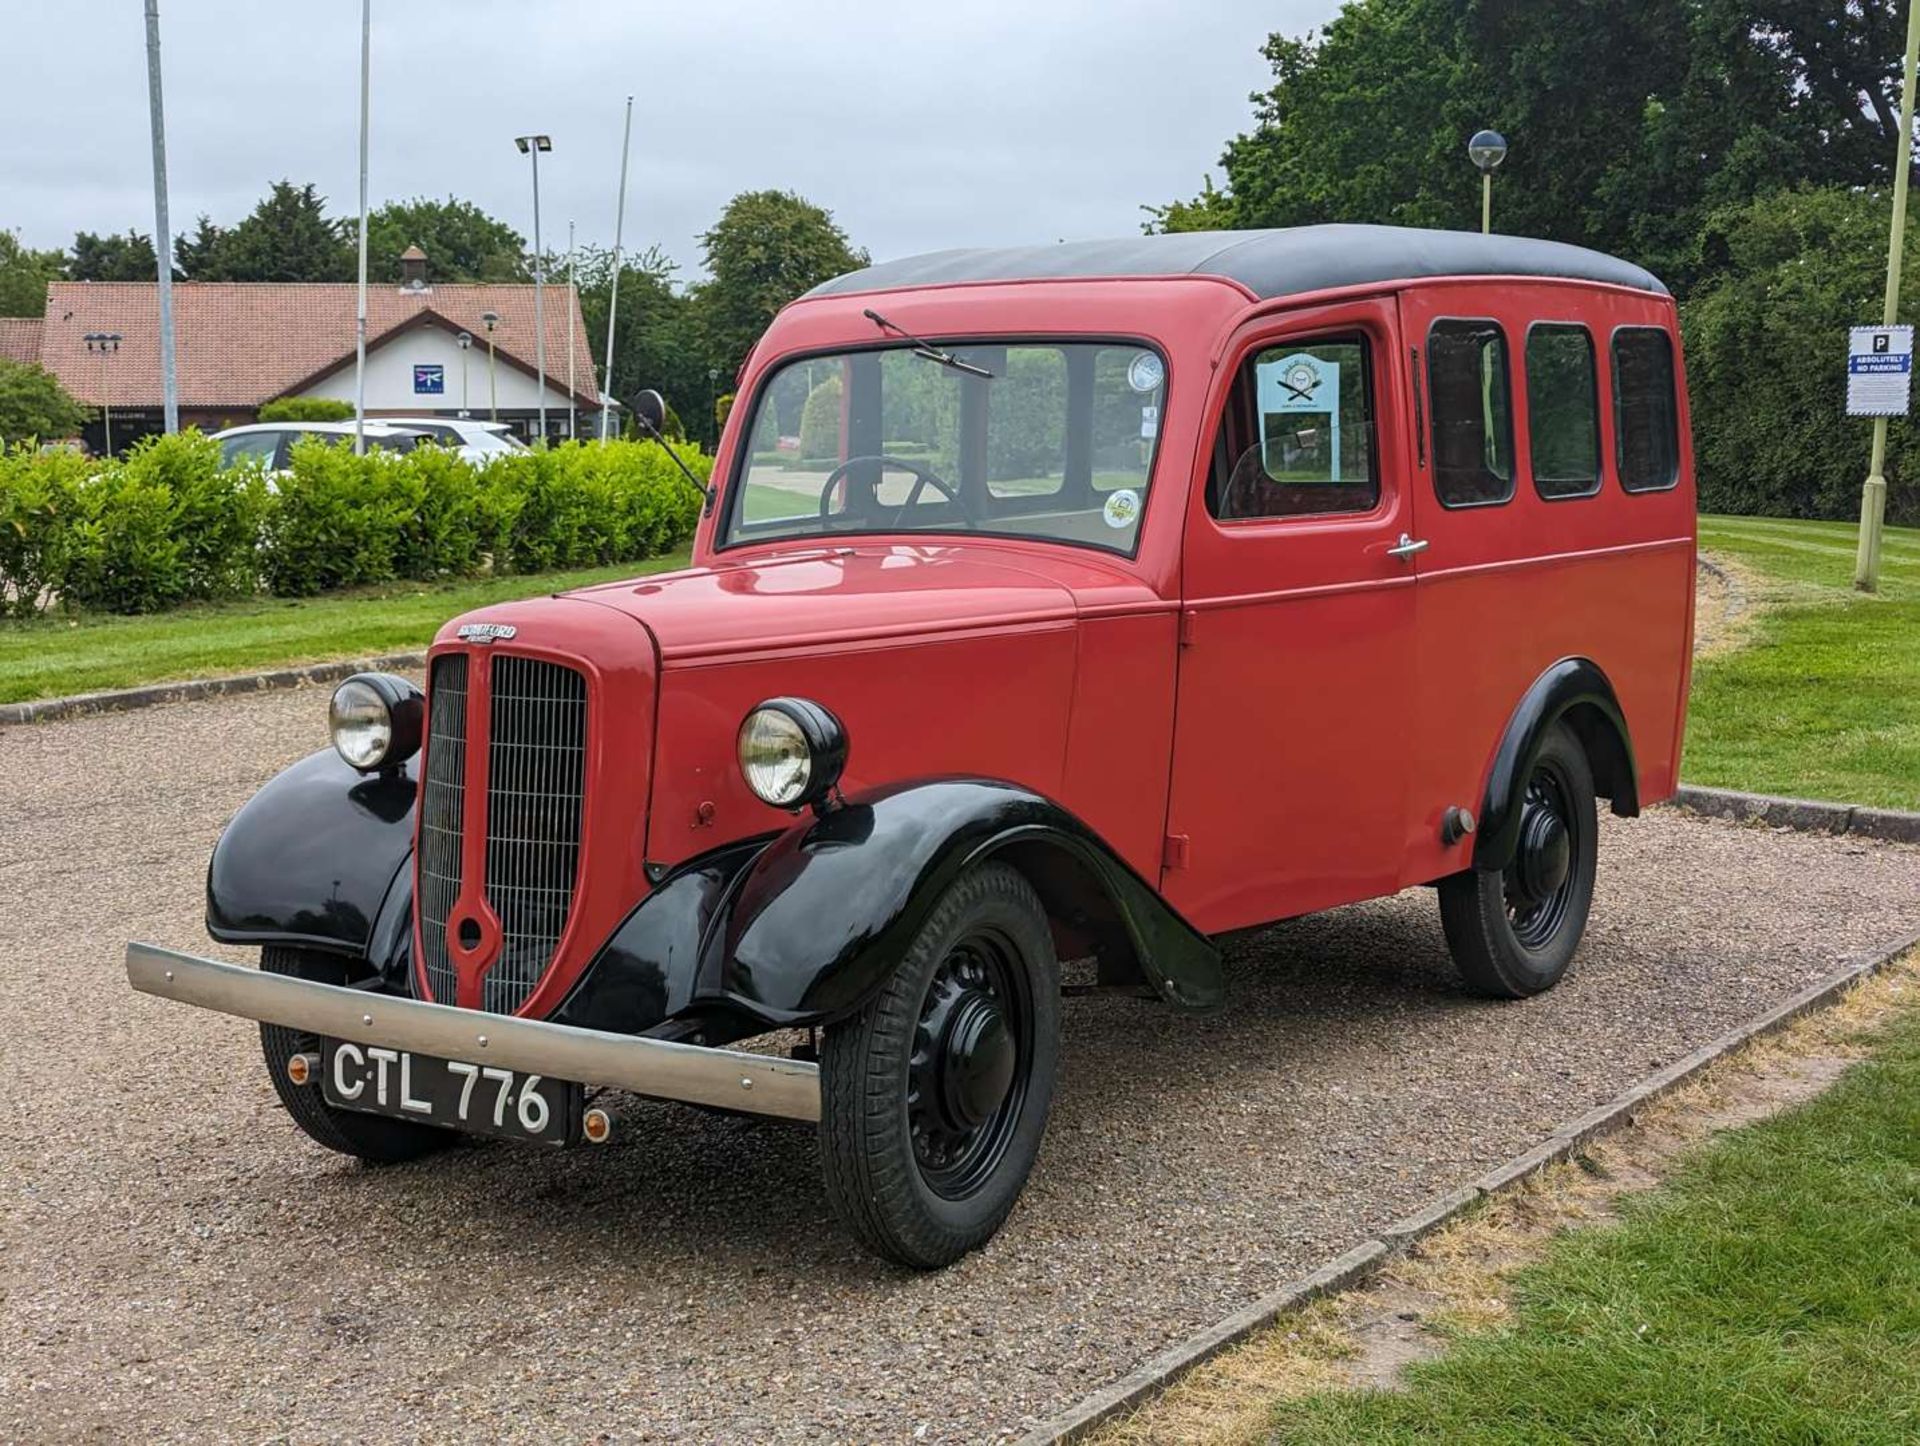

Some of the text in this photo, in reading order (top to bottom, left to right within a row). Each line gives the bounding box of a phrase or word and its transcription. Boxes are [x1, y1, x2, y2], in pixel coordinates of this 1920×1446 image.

[1876, 337, 1886, 350] P
[1856, 355, 1905, 364] ABSOLUTELY
[1856, 363, 1903, 372] NO PARKING
[333, 1043, 550, 1134] CTL 776
